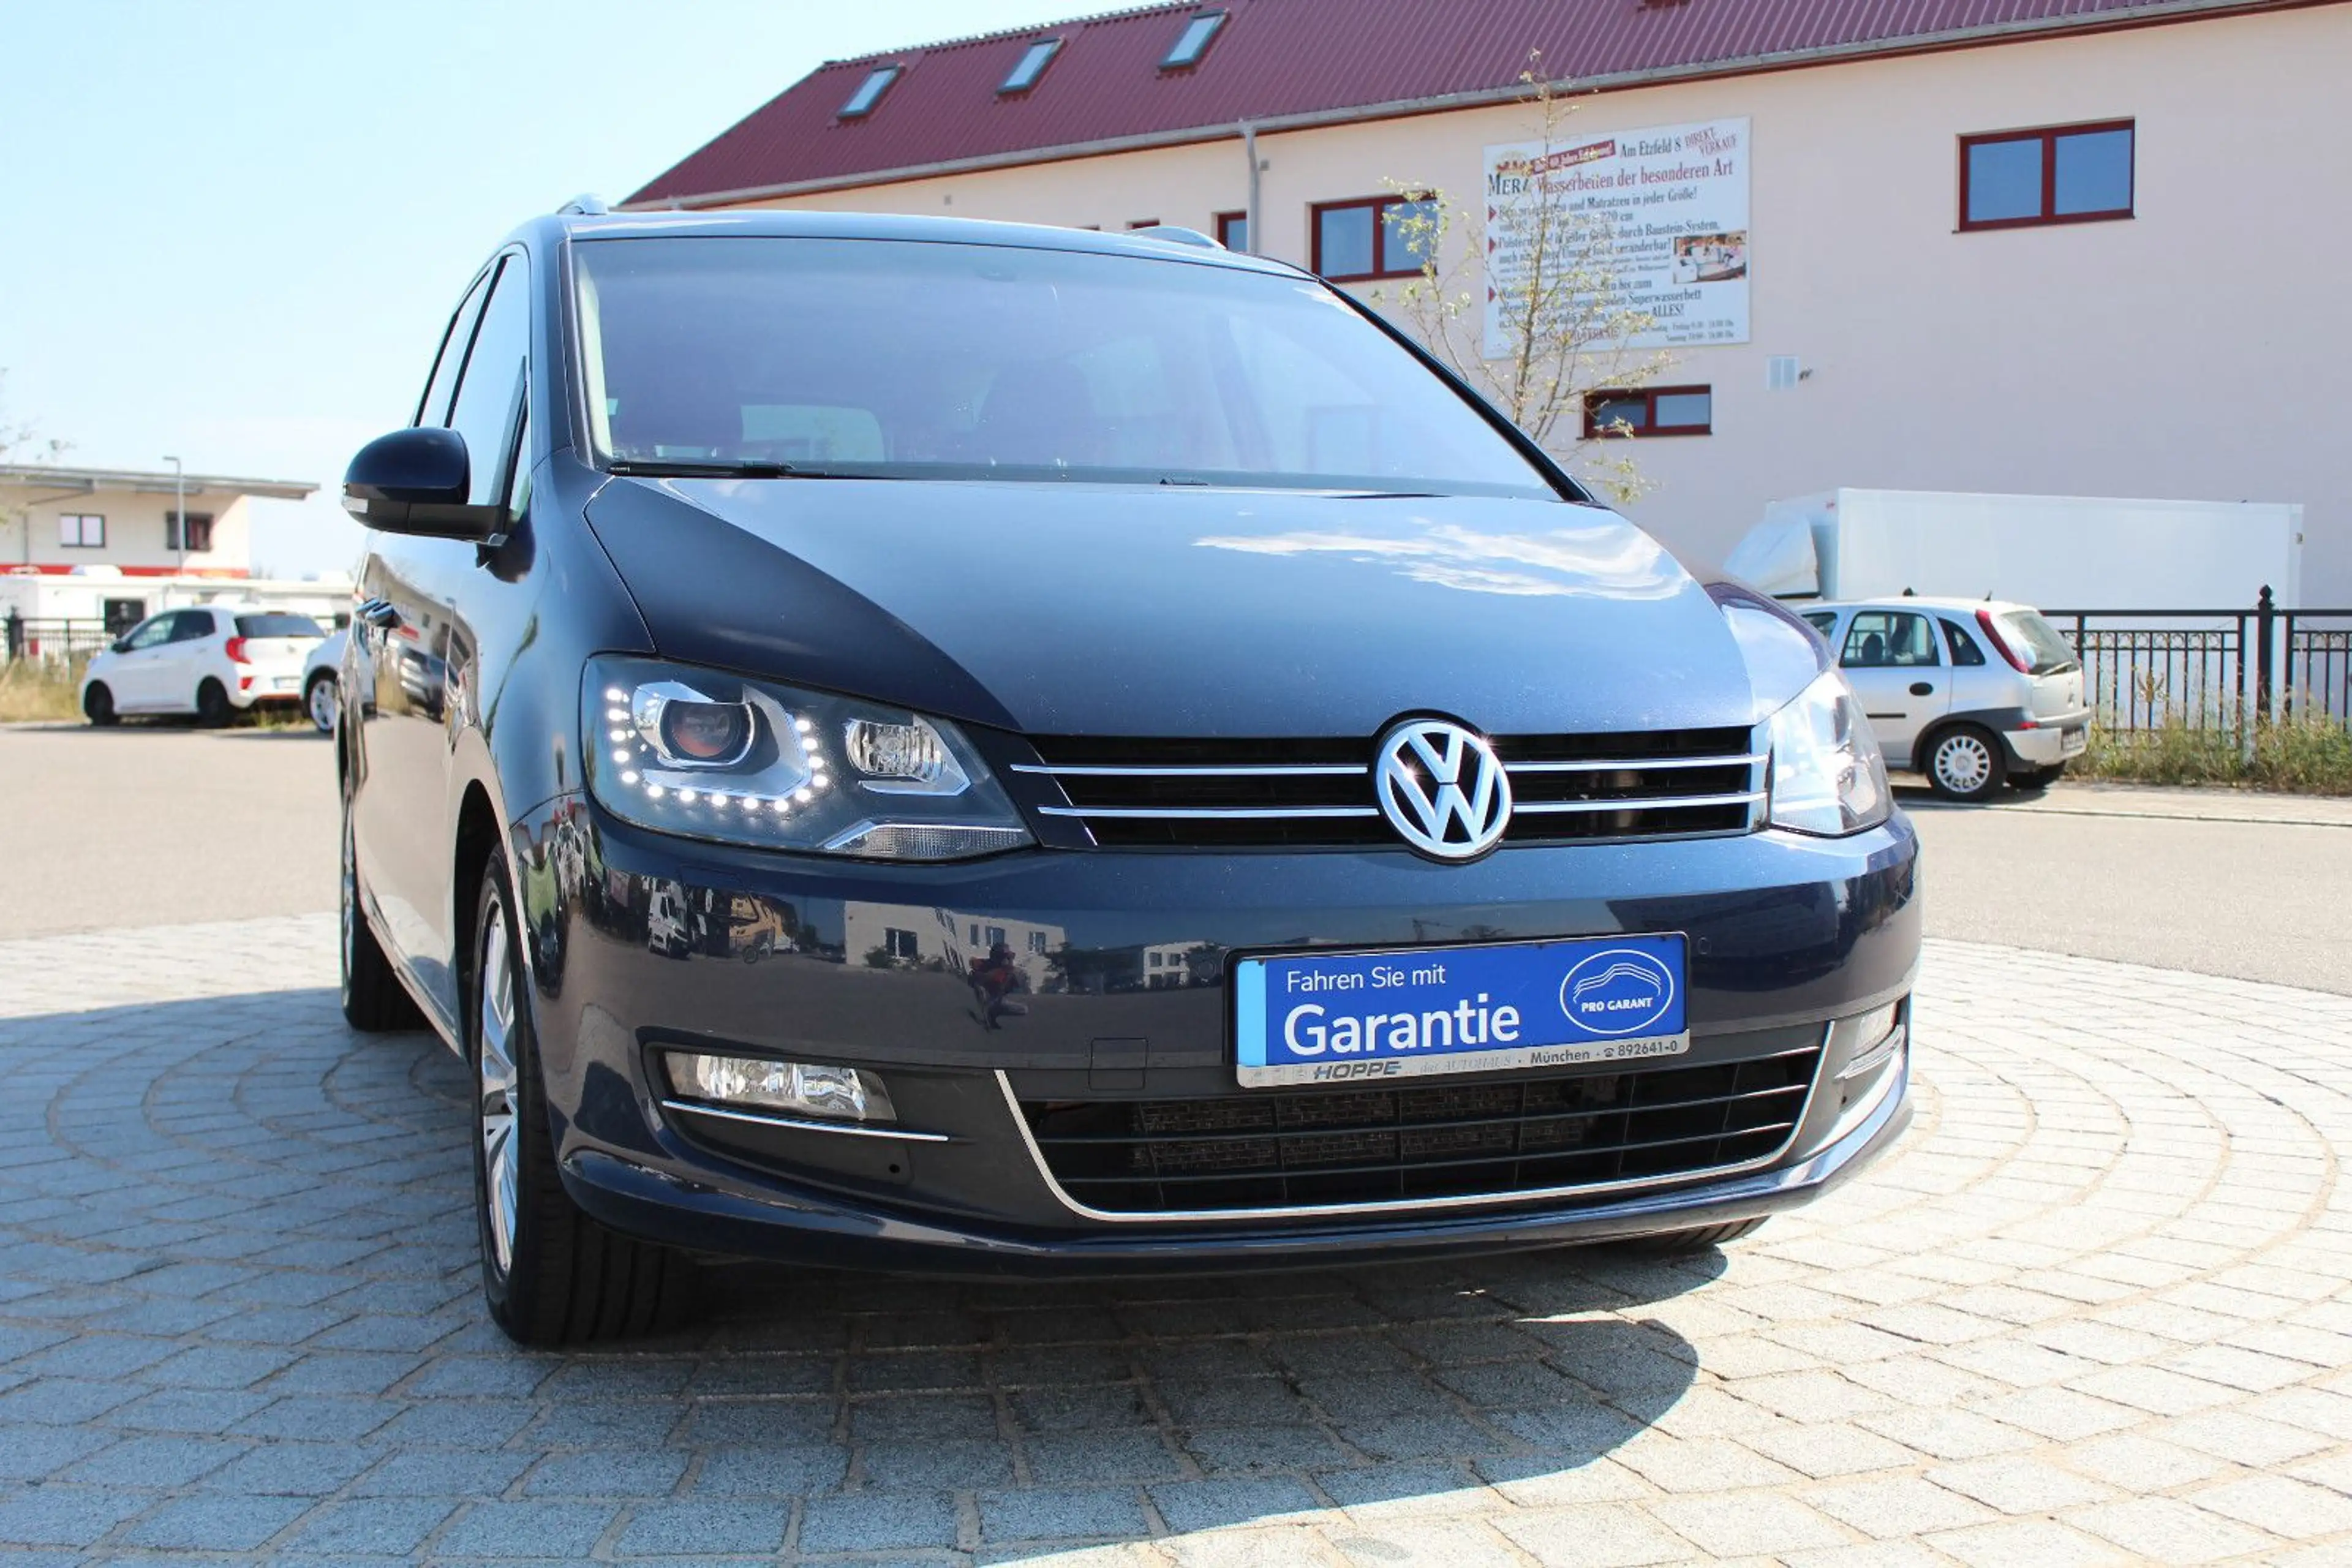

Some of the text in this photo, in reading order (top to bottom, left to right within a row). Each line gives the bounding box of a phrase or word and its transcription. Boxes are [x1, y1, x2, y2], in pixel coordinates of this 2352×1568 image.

[1620, 143, 1637, 157] Am
[1639, 137, 1672, 157] Etzfeld
[1617, 168, 1636, 187] der
[1640, 161, 1709, 184] besonderen
[1714, 157, 1733, 176] Art
[1587, 194, 1630, 209] Matratzen
[1643, 190, 1665, 206] jeder
[1618, 224, 1644, 239] durch
[1652, 303, 1684, 317] ALLES!
[1378, 723, 1510, 856] VW
[1287, 963, 1446, 993] Fahren Sie mit
[1581, 997, 1653, 1013] PRO GARANT
[1284, 992, 1520, 1057] Garantie
[1313, 1061, 1401, 1080] HOPPE
[1531, 1049, 1590, 1064] München
[1618, 1040, 1678, 1057] 892641-0
